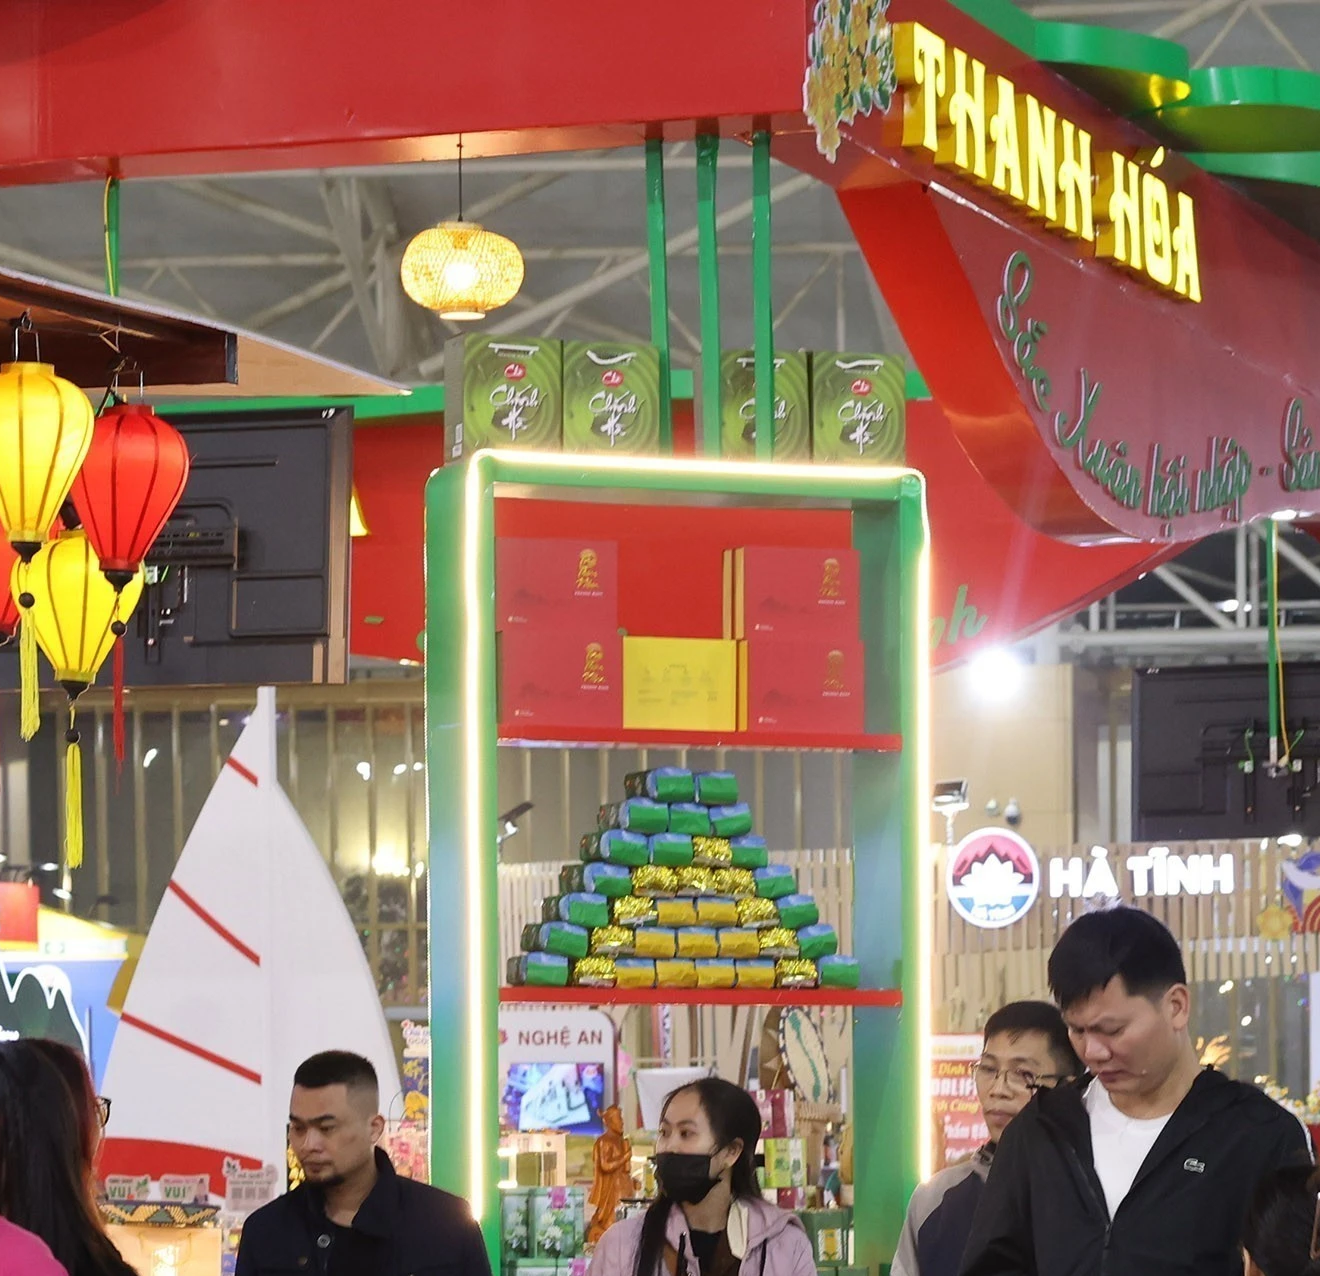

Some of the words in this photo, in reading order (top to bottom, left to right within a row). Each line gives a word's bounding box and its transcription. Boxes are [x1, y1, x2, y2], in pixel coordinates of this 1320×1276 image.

[912, 22, 1093, 242] THANH
[1108, 146, 1202, 302] HÓA
[997, 250, 1051, 412] Sắc
[1054, 367, 1141, 510] Xuân
[1145, 442, 1189, 537] hội
[1192, 436, 1252, 522] nhập
[1049, 846, 1120, 898] HÀ
[1126, 847, 1234, 895] TĨNH
[518, 1026, 571, 1047] NGHỆ
[578, 1029, 603, 1045] AN
[164, 1186, 186, 1198] VUI
